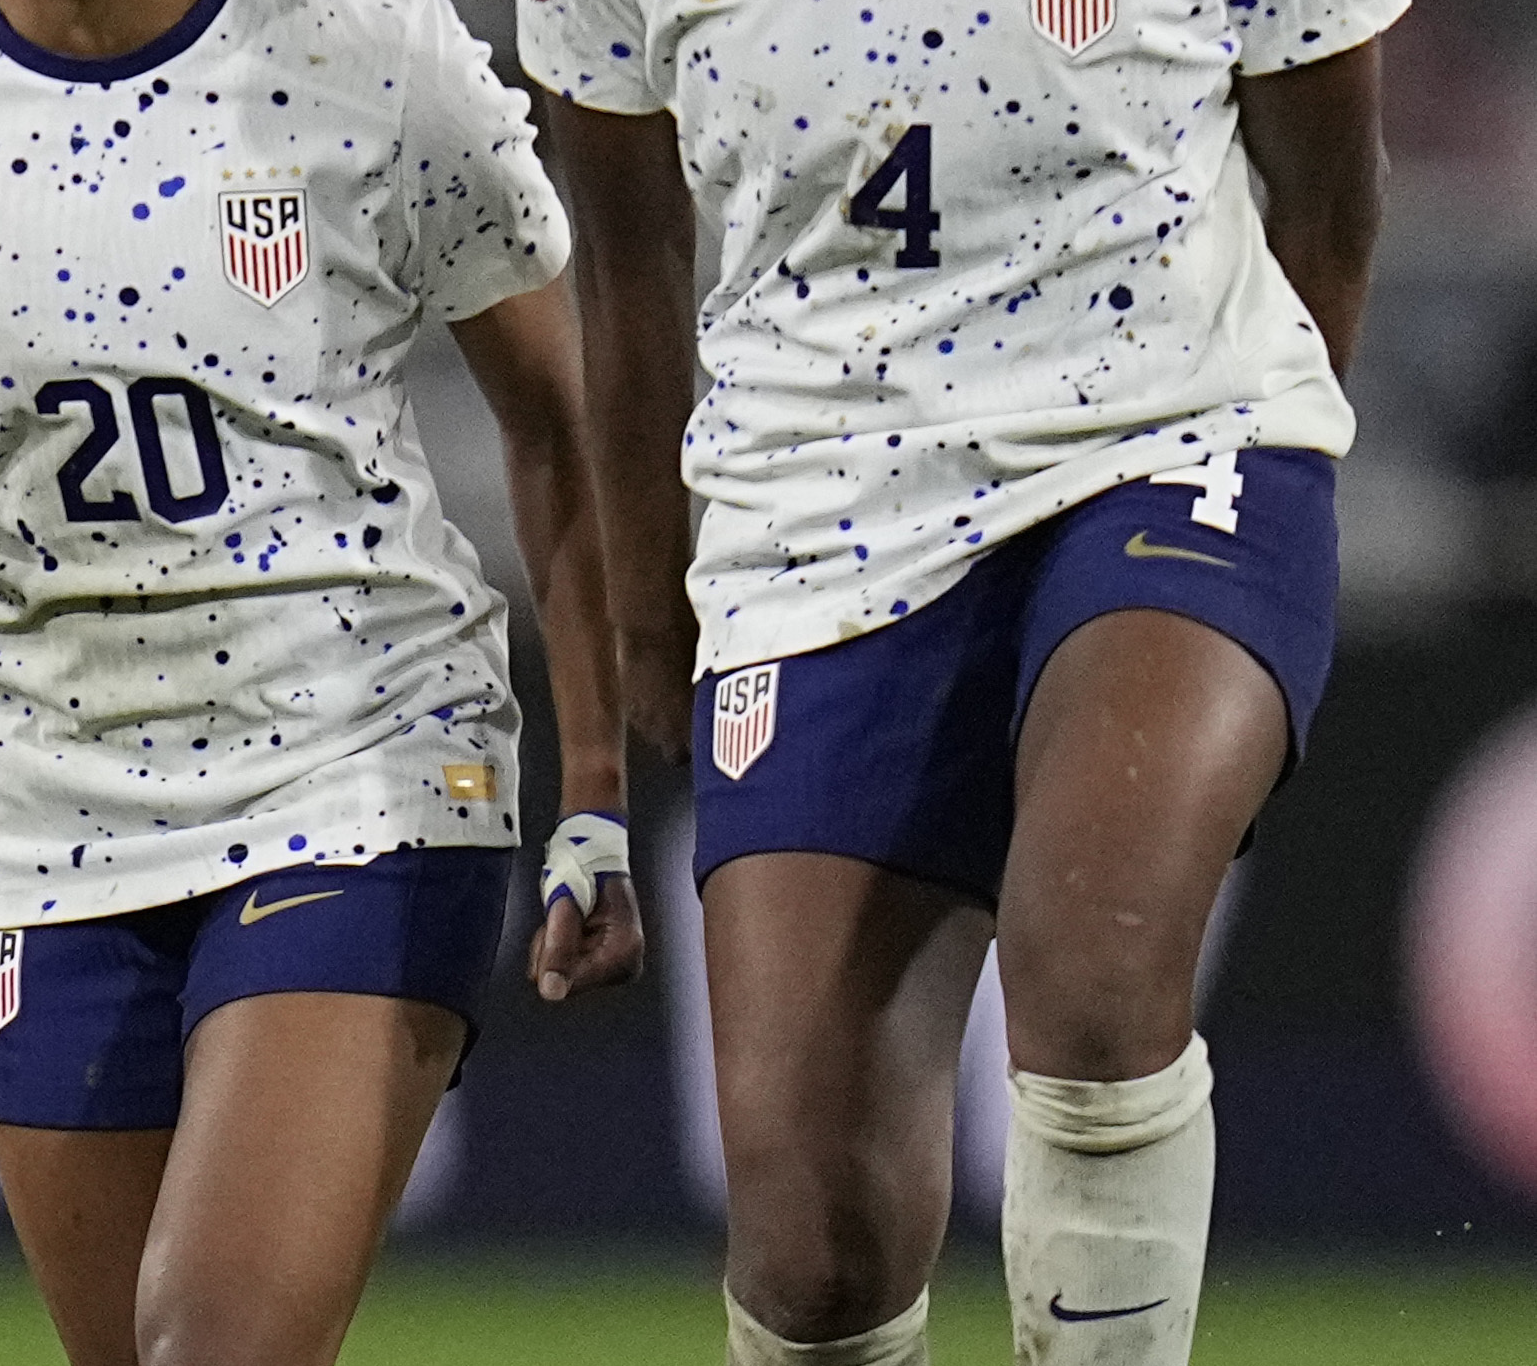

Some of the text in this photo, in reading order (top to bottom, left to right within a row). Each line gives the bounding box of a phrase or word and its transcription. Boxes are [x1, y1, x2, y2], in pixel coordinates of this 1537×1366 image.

[227, 197, 299, 239] USA
[849, 124, 940, 268] 4
[33, 377, 232, 524] 20
[718, 671, 771, 715] USA
